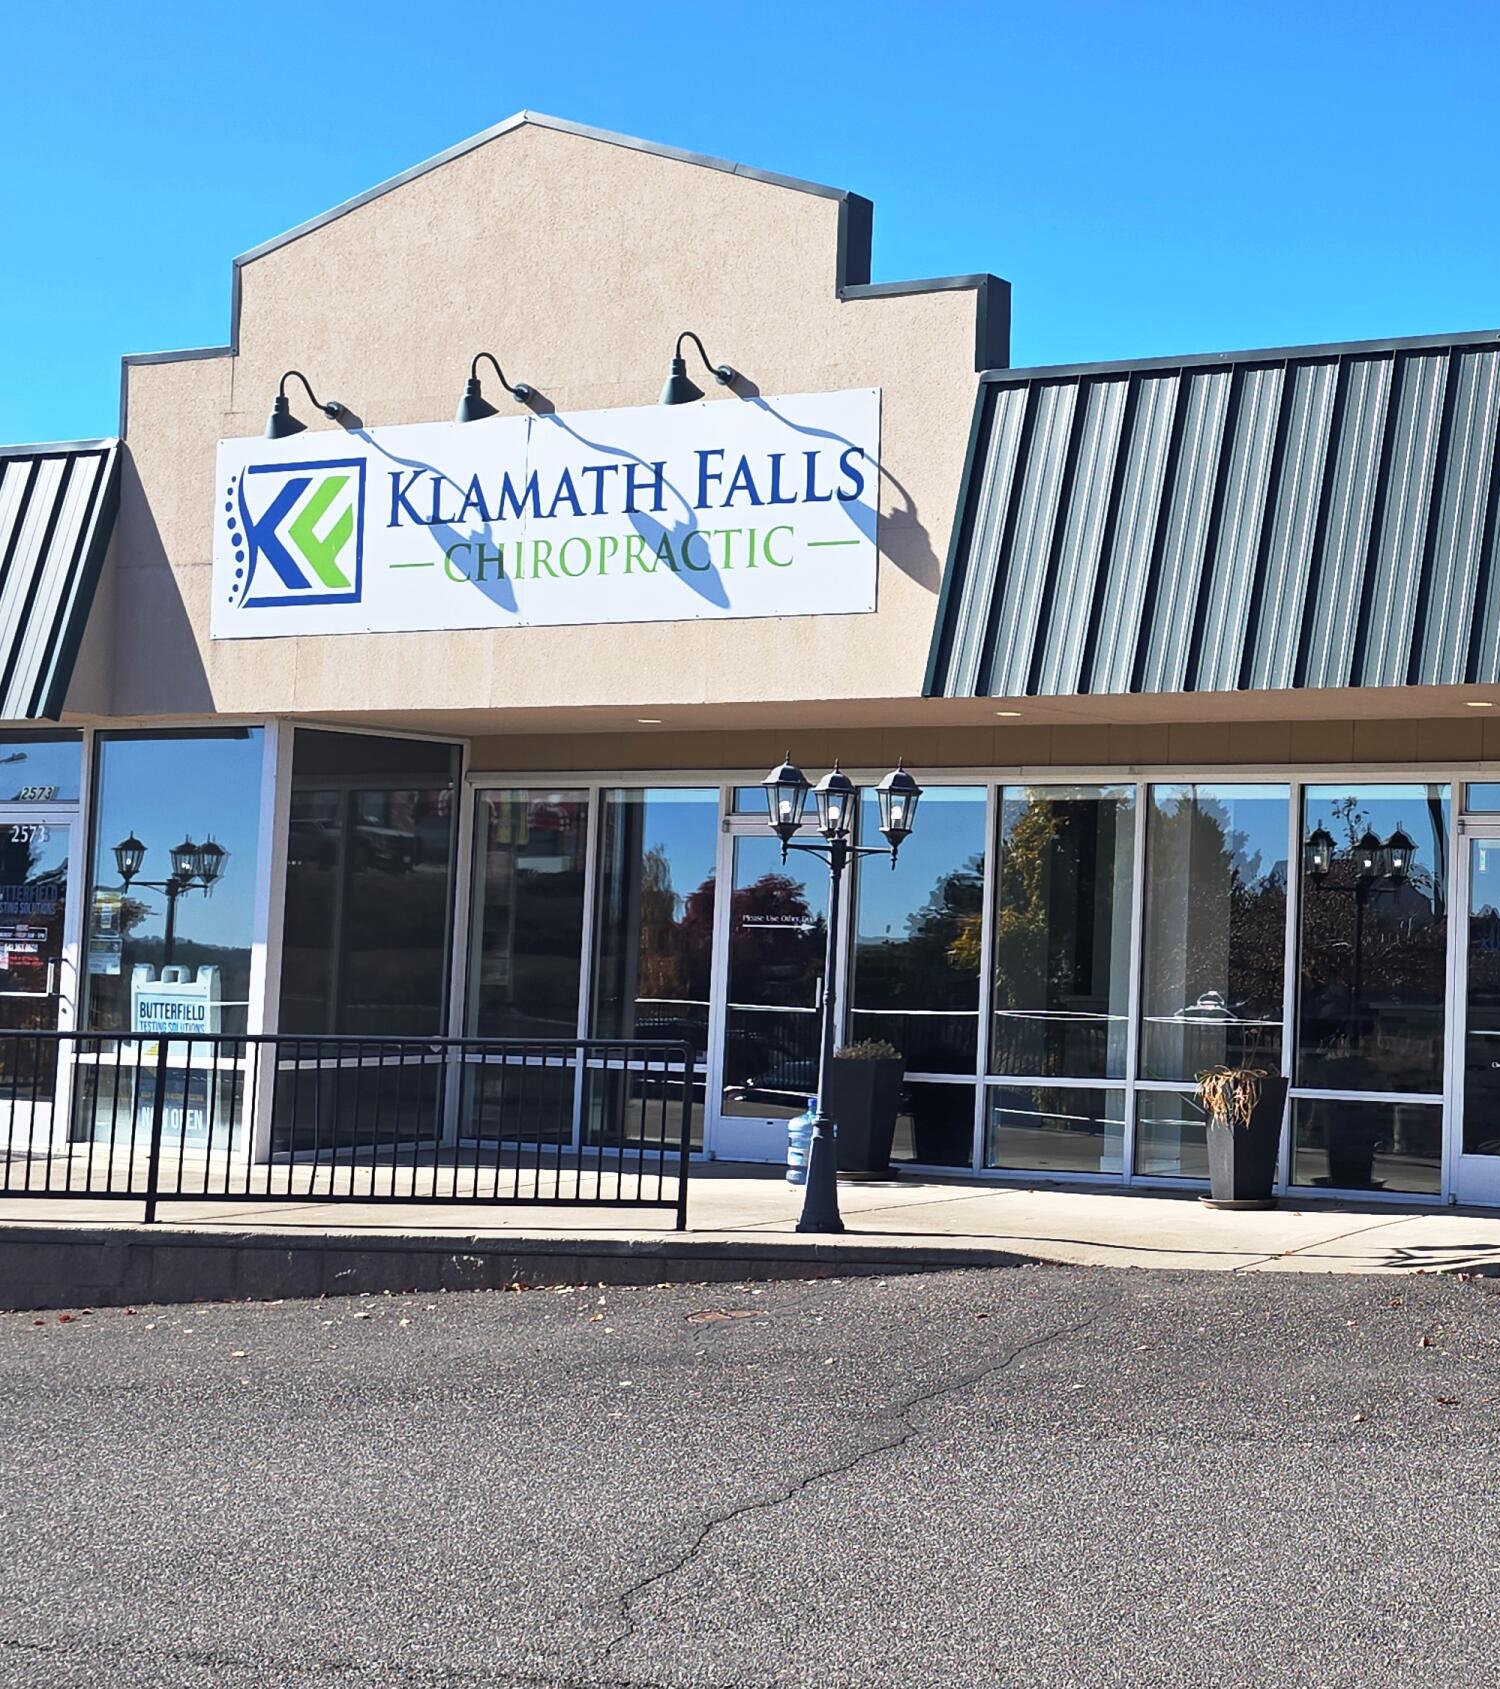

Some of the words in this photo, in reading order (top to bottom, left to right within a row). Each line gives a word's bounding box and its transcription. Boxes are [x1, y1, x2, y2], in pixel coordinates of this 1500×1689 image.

[443, 525, 795, 584] CHIROPRACTIC
[20, 786, 54, 800] 2573
[11, 825, 46, 843] 2573
[140, 1001, 205, 1021] BUTTERFIELD
